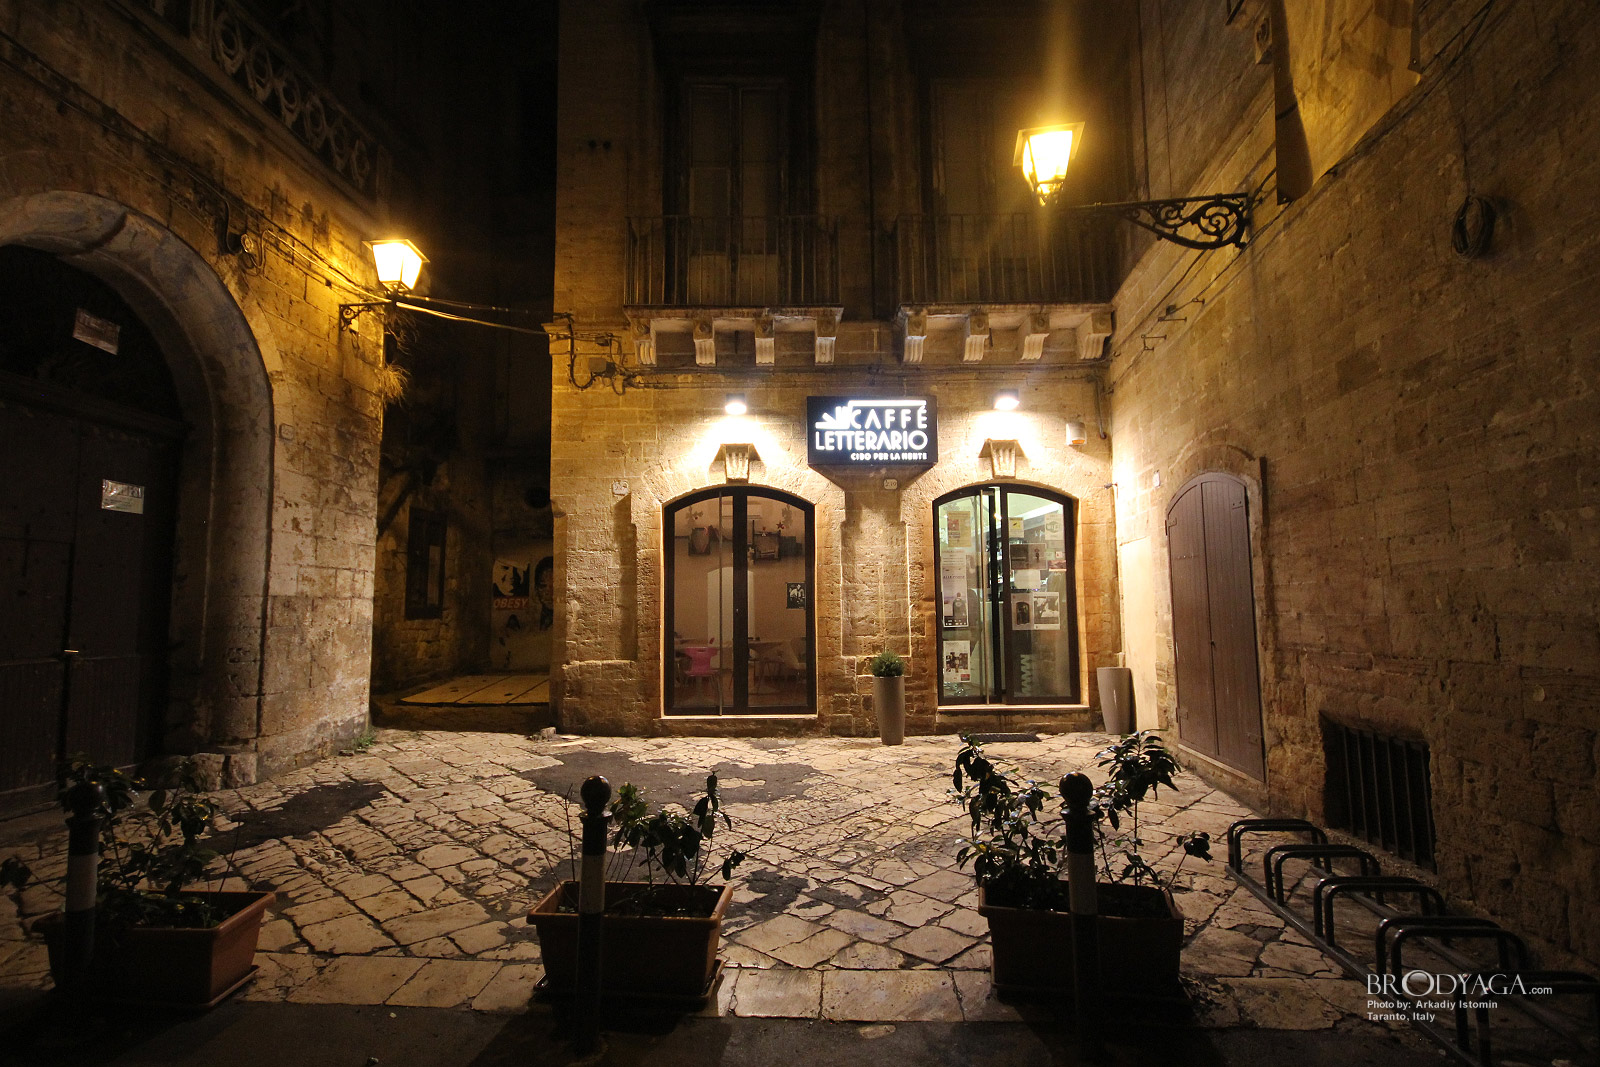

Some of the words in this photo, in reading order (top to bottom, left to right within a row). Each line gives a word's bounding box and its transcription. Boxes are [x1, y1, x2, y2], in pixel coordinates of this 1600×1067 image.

[815, 430, 929, 450] LETTERARIO
[873, 452, 889, 460] PER
[890, 452, 901, 460] LA
[493, 598, 529, 609] OBESY
